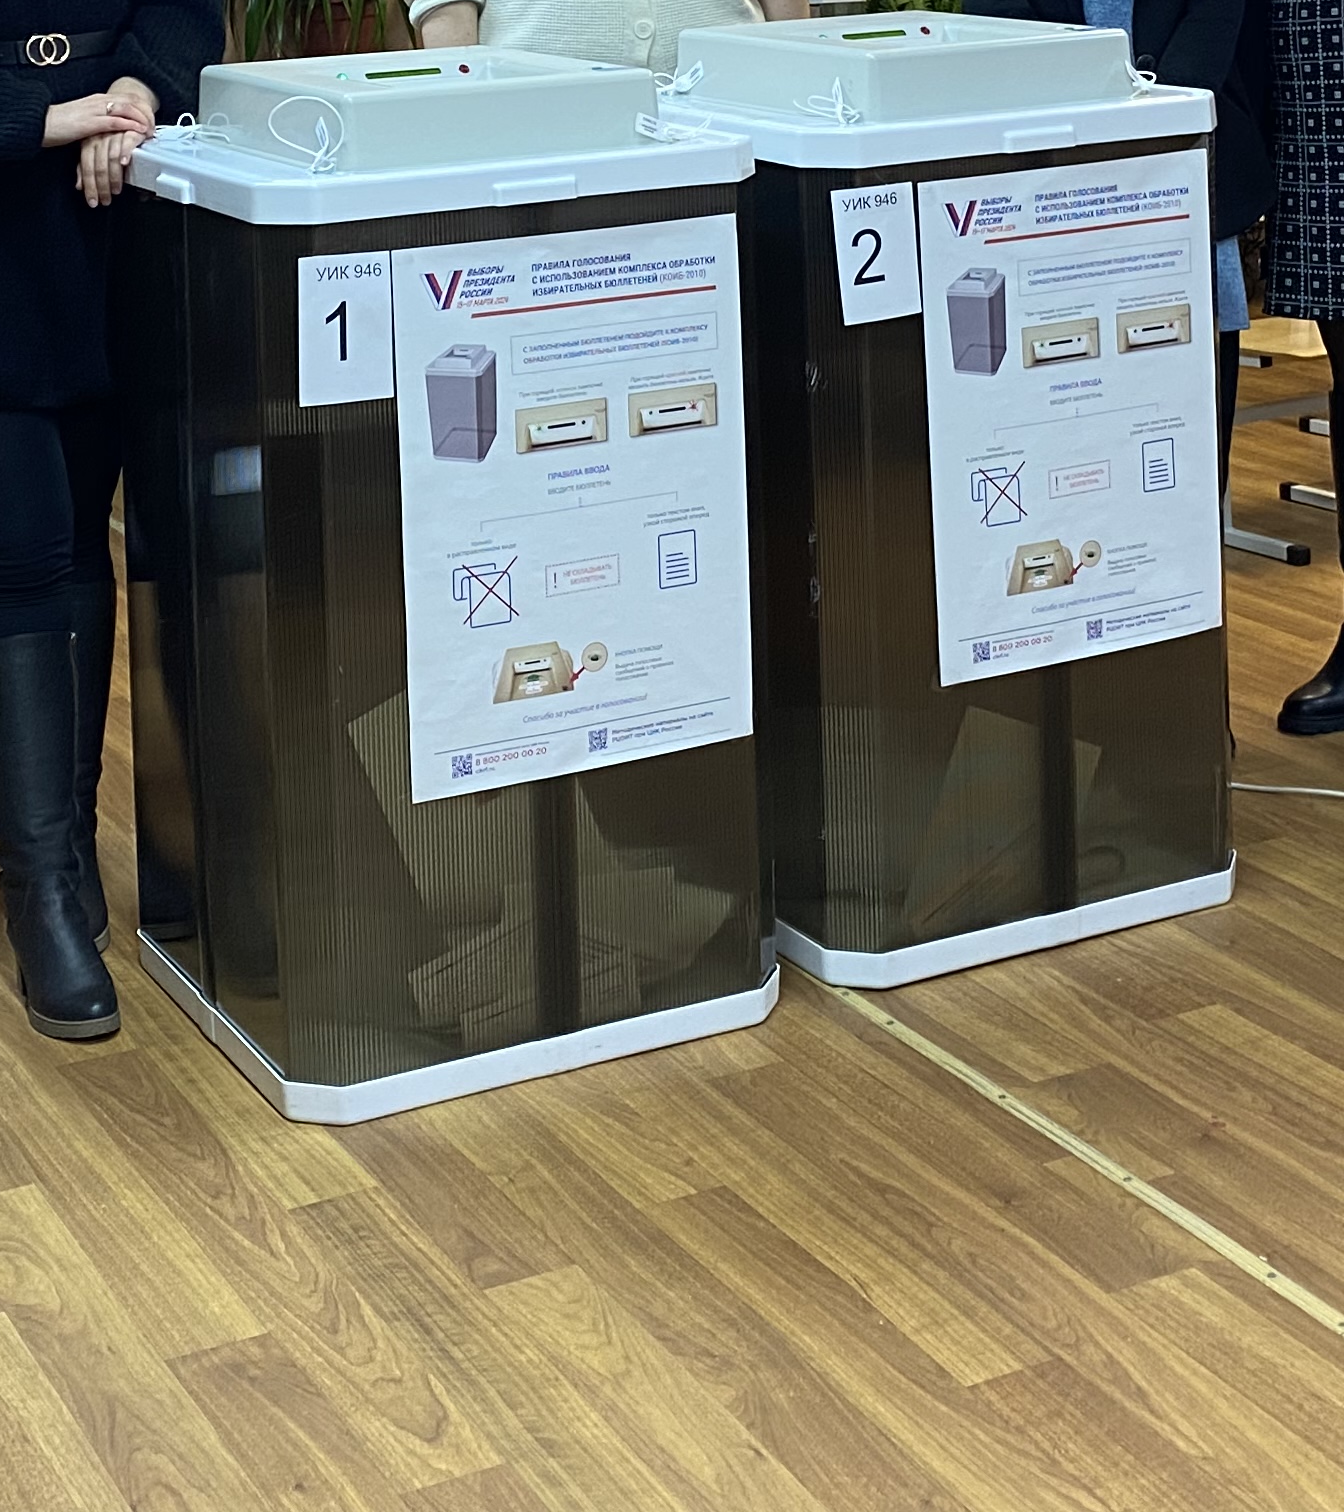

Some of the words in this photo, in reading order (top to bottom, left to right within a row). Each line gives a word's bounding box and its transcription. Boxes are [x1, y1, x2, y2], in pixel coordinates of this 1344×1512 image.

[842, 196, 871, 212] УИК
[874, 192, 898, 208] 946
[1034, 191, 1067, 202] ПРАВИЛА
[1149, 187, 1189, 199] ОБРАБОТКИ
[974, 217, 1003, 226] РОССИИ
[531, 259, 570, 272] ПРАВИЛА
[572, 253, 631, 267] ГОЛОСОВАНИЯ
[852, 229, 886, 286] 2
[316, 265, 349, 282] УИК
[354, 263, 382, 278] 946
[466, 265, 505, 277] ВЫБОРЫ
[532, 276, 537, 285] С
[539, 267, 616, 283] ИСПОЛЬЗОВАНИЕМ
[618, 262, 667, 274] КОМПЛЕКСА
[669, 256, 715, 269] ОБРАБОТКИ
[463, 275, 515, 288] ПРЕЗИДЕНТА
[532, 281, 602, 297] ИЗБИРАТЕЛЬНЫХ
[604, 274, 658, 288] БЮЛЛЕТЕНЕЙ
[659, 269, 707, 283] (КОИБ-2010)
[459, 288, 493, 299] РОССИИ
[325, 301, 348, 361] 1
[475, 758, 481, 766] 8
[482, 754, 500, 765] 800
[502, 751, 519, 762] 200
[521, 748, 533, 758] 00
[536, 746, 547, 756] 20
